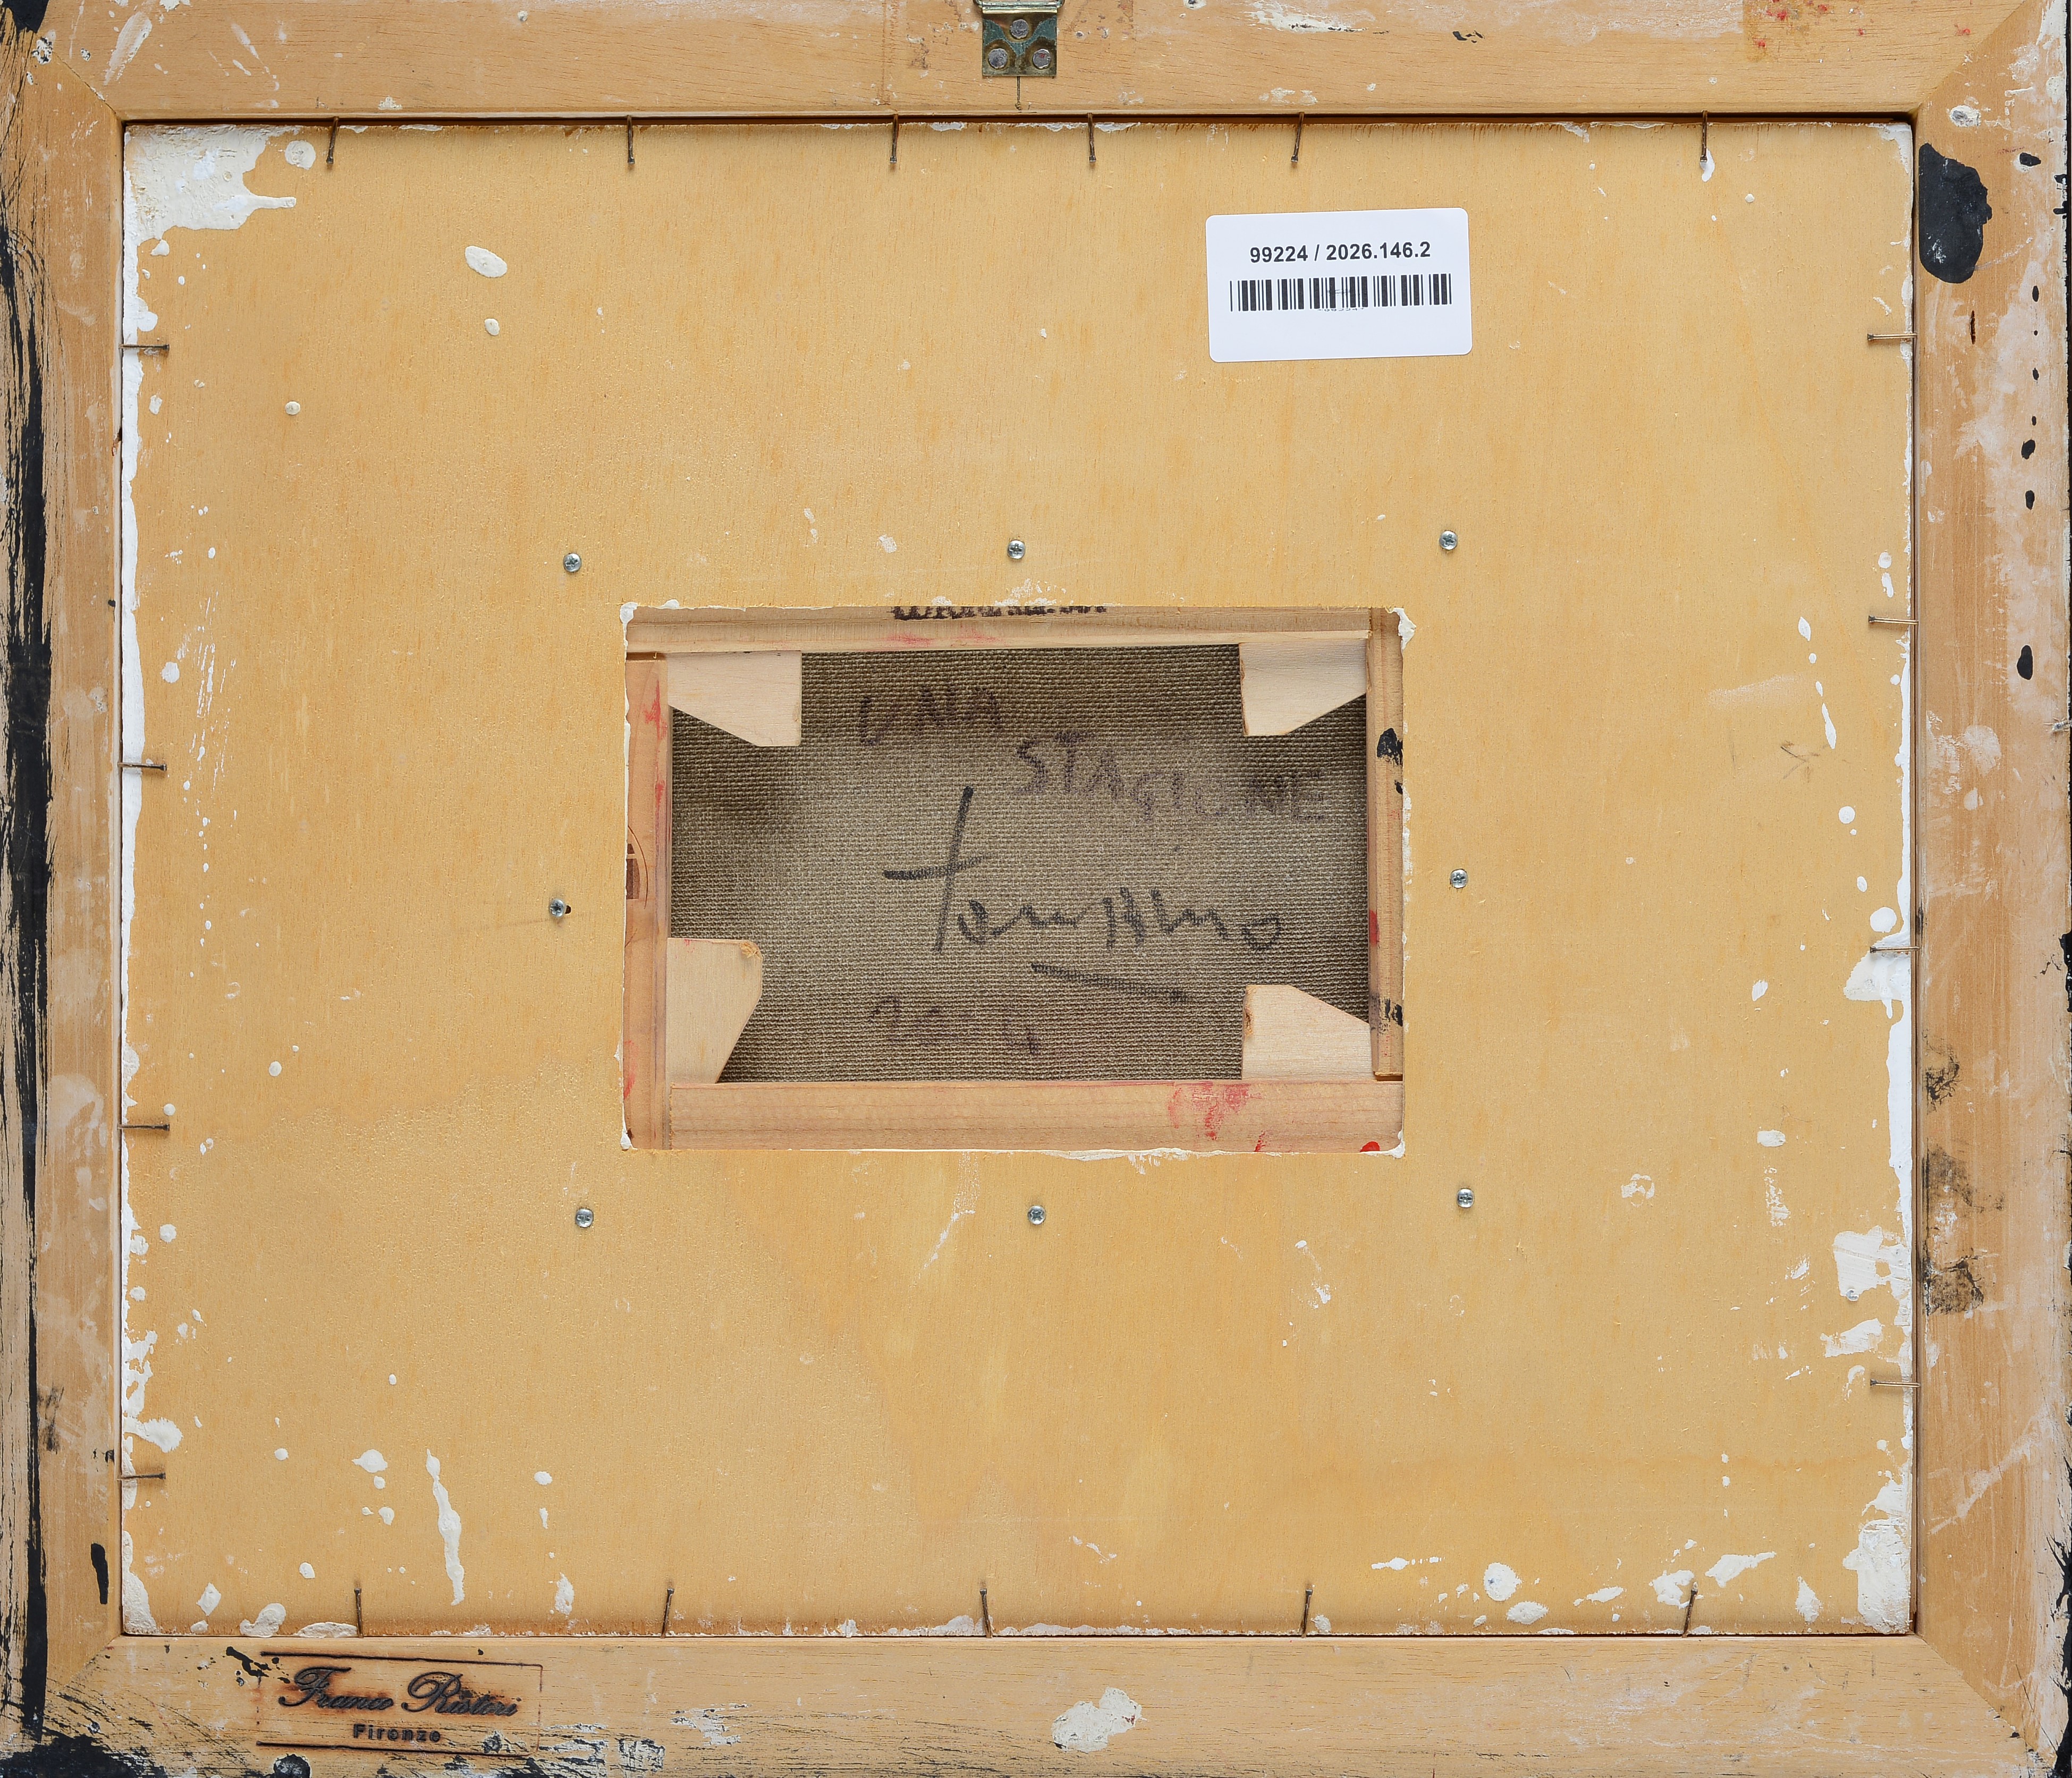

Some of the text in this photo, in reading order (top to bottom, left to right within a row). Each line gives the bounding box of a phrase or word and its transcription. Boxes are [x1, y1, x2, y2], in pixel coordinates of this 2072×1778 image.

[1250, 241, 1431, 263] 99224 / 2026.146.2
[278, 1666, 394, 1709] Franco
[352, 1724, 441, 1742] Firenze
